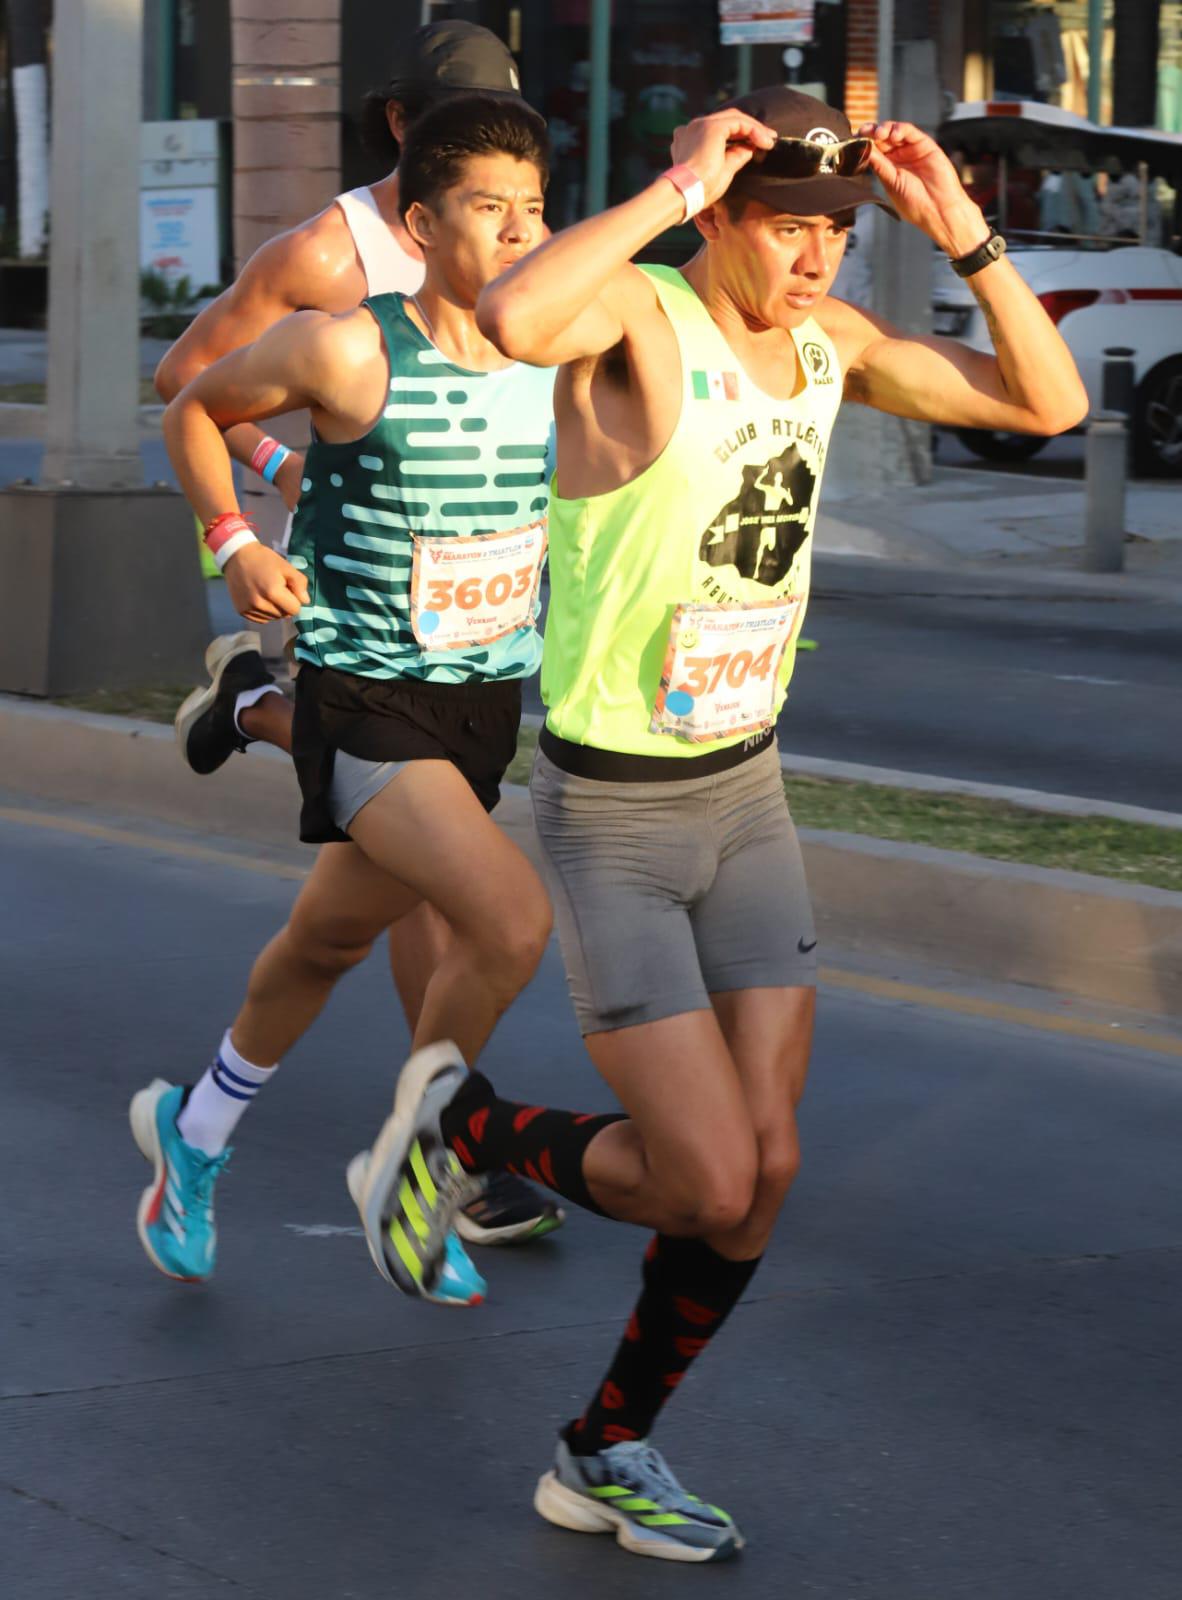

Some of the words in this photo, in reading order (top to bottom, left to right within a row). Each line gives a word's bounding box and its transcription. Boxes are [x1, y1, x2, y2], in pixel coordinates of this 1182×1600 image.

[713, 422, 757, 464] CLUB
[424, 564, 534, 612] 3603
[676, 644, 777, 698] 3704
